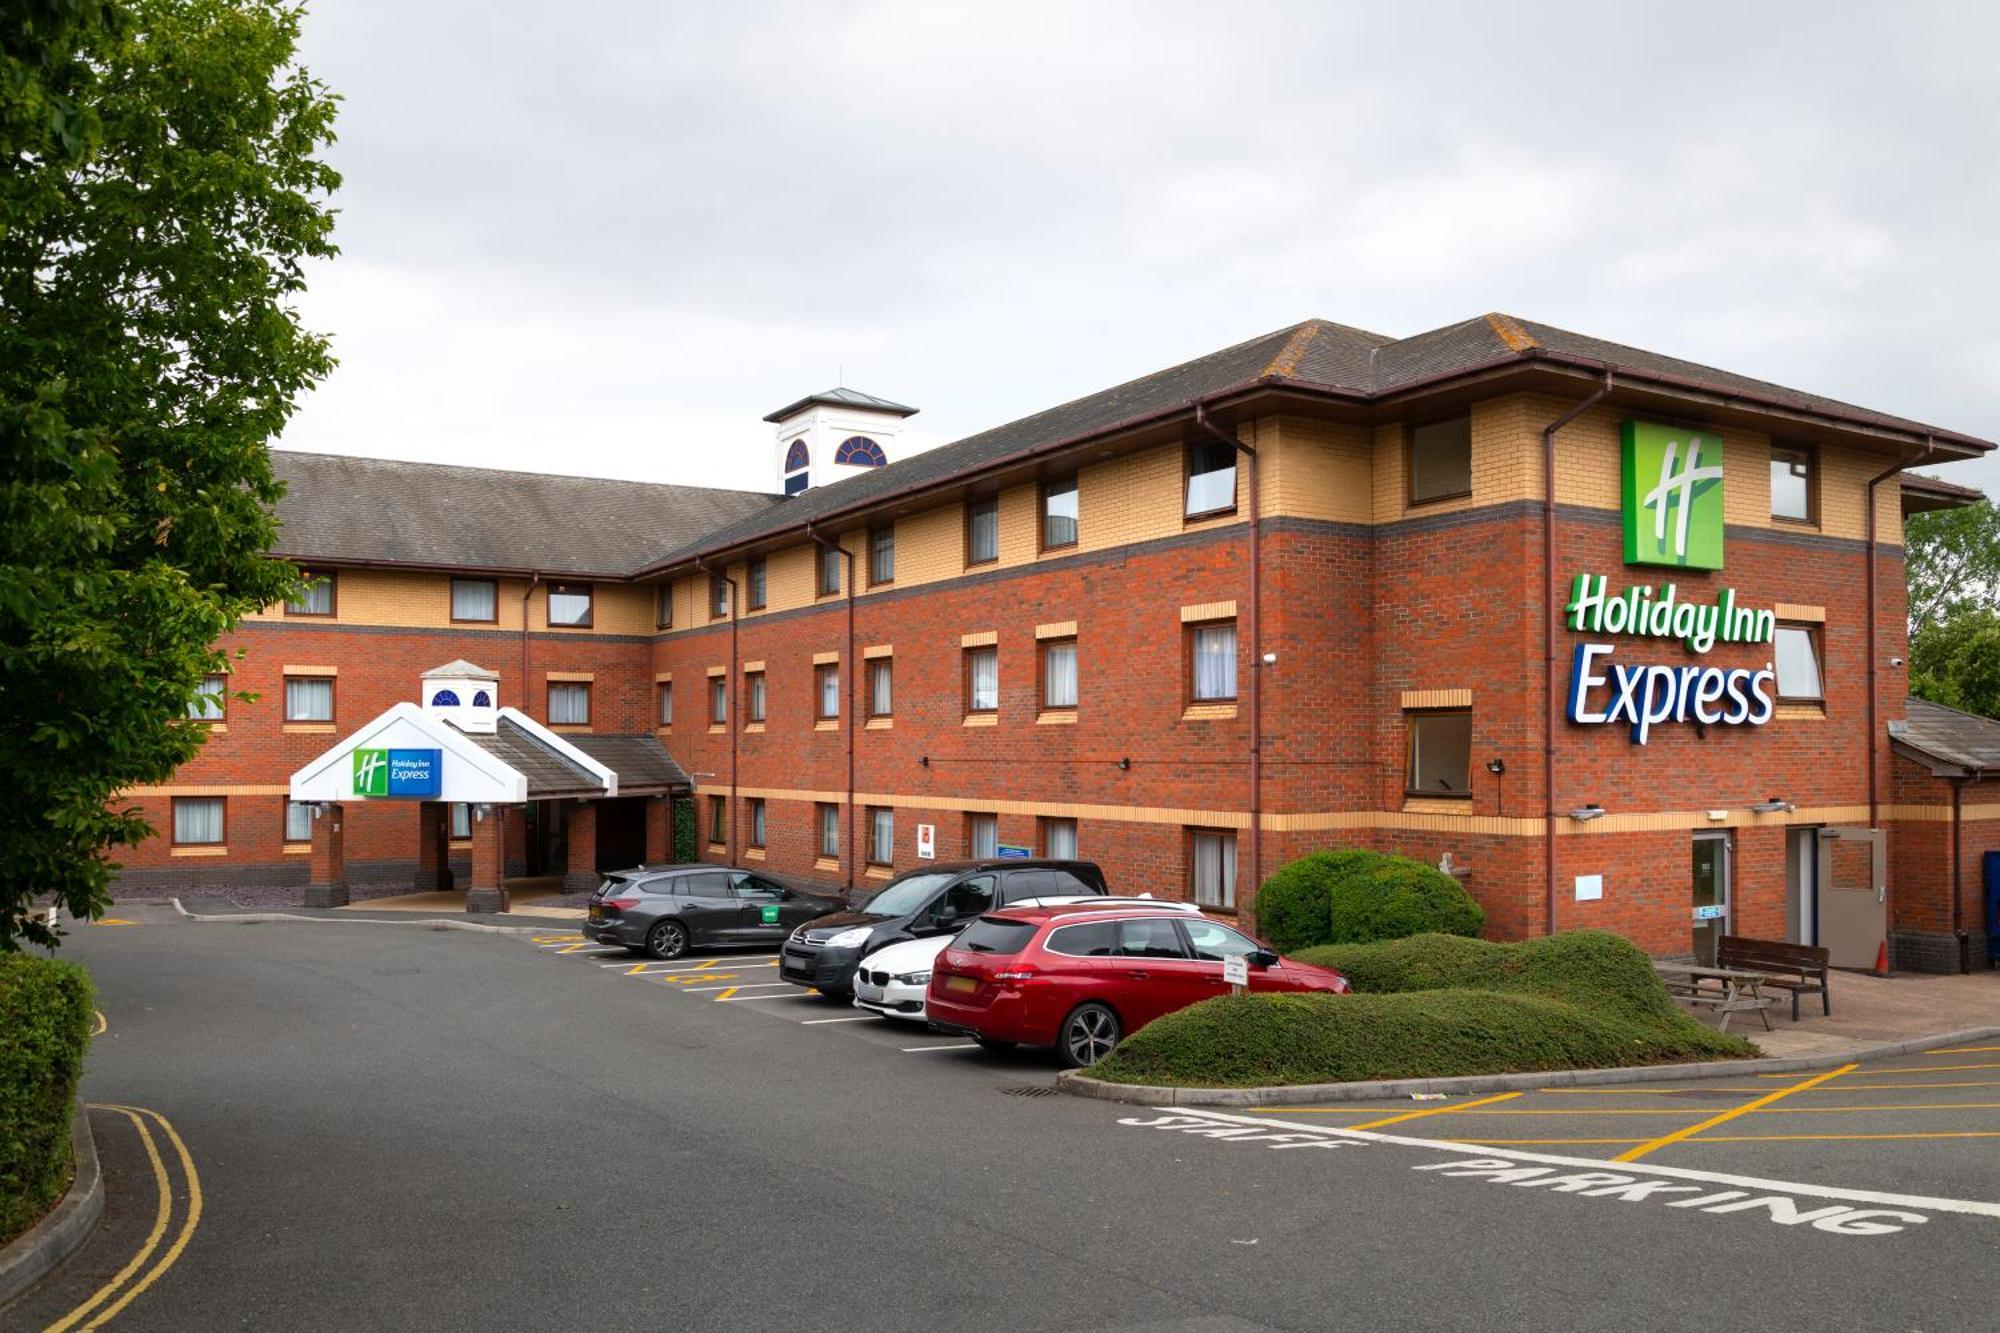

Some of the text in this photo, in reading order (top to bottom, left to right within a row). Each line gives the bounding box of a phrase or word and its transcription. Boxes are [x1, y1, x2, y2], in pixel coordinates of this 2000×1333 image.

[1567, 573, 1775, 653] Holiday Inn
[1570, 643, 1775, 746] Express
[391, 760, 417, 769] Holiday
[391, 768, 429, 781] Express
[1115, 1115, 1929, 1235] STAFF PARKING
